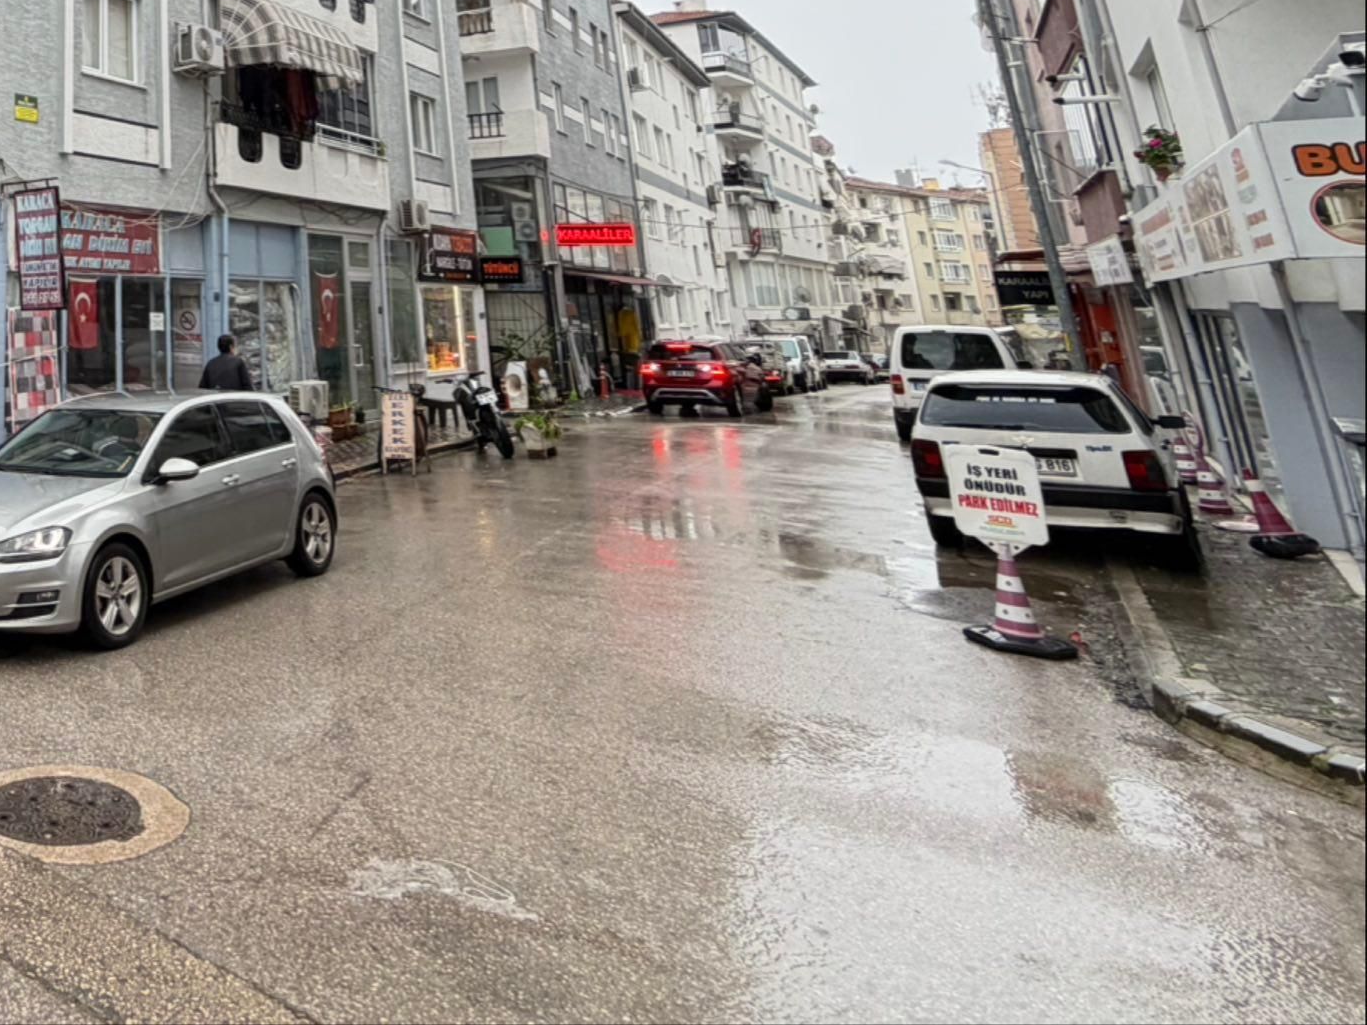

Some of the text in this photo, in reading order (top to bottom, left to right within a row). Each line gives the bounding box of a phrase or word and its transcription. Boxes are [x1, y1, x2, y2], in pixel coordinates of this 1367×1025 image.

[61, 208, 126, 233] KARACA
[558, 228, 631, 241] KARAALİLER
[984, 466, 1018, 480] YERİ
[964, 478, 1026, 496] ÖNÜDÜR
[958, 494, 1039, 518] PARK EDİLMEZ
